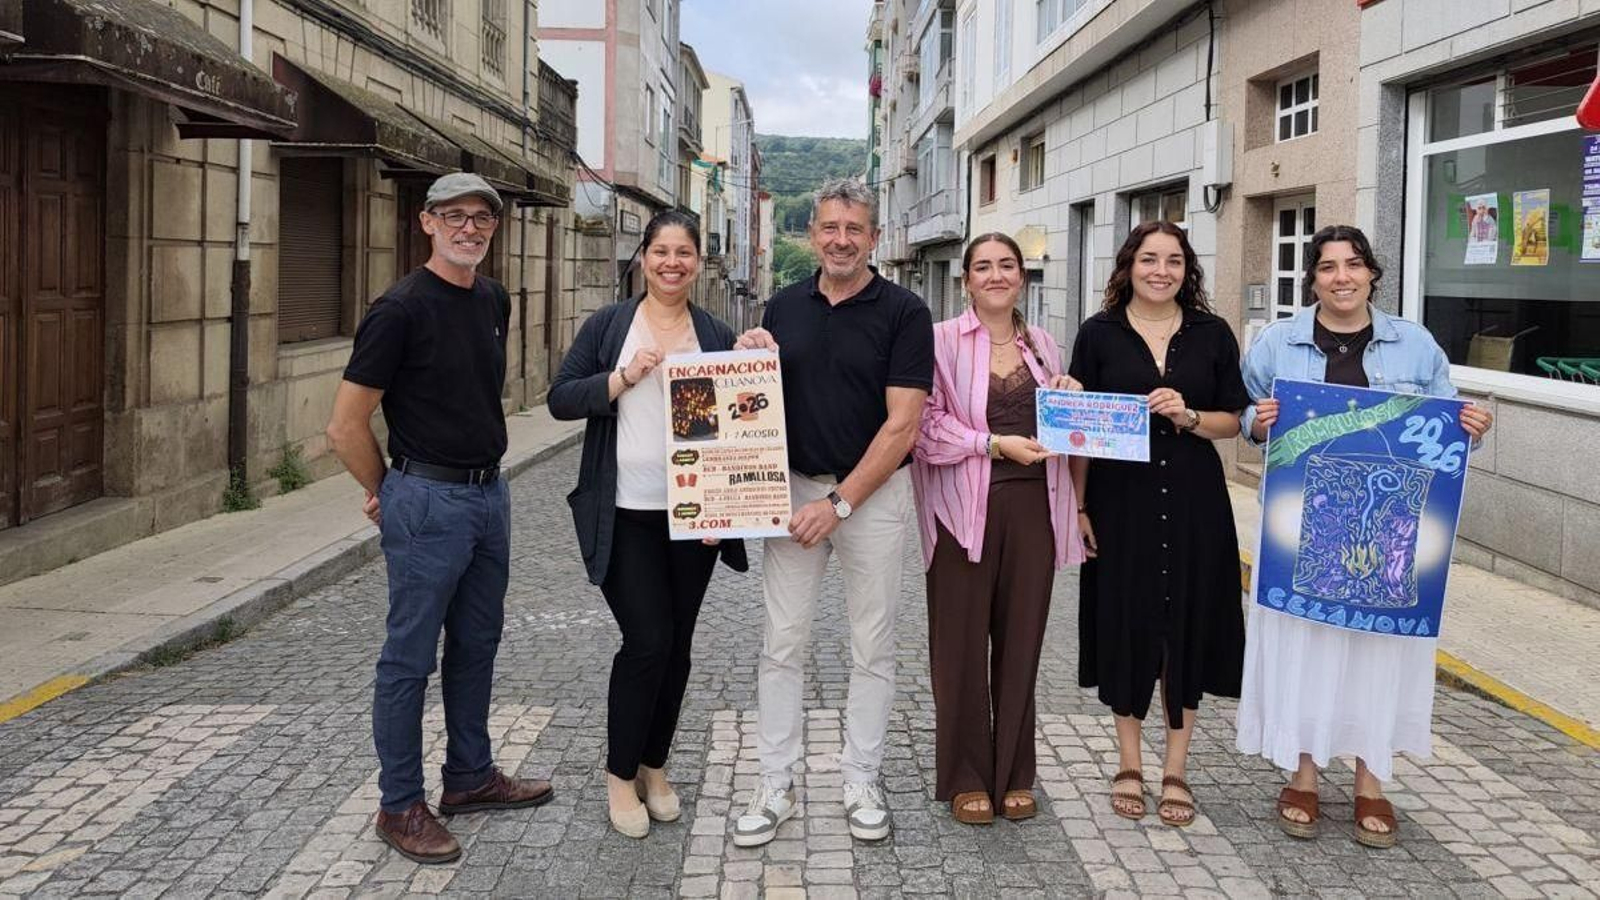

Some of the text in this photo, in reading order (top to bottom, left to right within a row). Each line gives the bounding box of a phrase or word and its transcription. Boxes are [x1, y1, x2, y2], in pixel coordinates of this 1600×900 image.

[669, 360, 777, 378] ENCARNACIÓN
[714, 375, 777, 389] CELANOVA
[741, 428, 779, 439] AGOSTO
[1284, 399, 1401, 458] RAMALLOSA
[729, 471, 786, 486] RAMALLOSA
